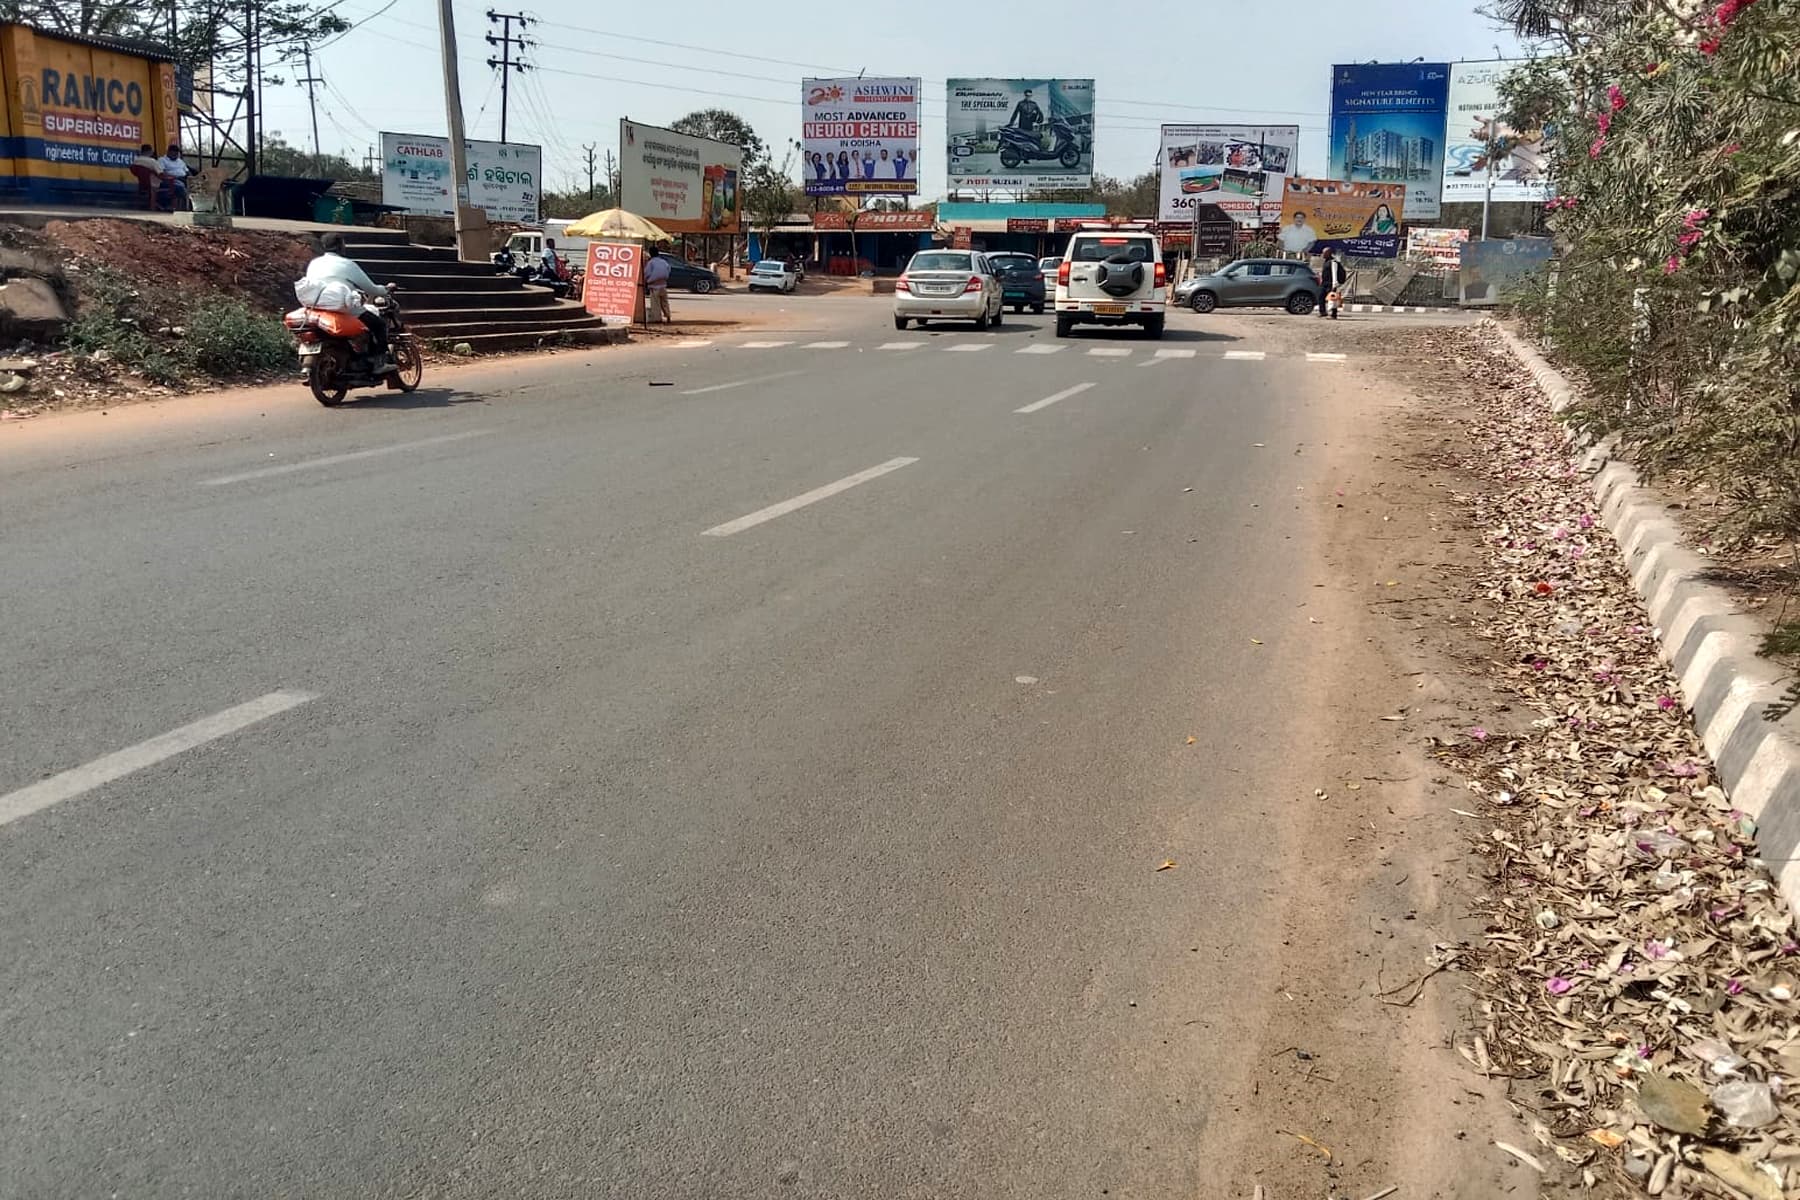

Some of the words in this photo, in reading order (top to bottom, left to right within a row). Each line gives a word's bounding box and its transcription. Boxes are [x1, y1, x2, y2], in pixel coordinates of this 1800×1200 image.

[42, 68, 142, 116] RAMCO
[855, 86, 913, 96] ASHWINI
[815, 112, 844, 121] MOST
[847, 112, 906, 121] ADVANCED
[45, 115, 140, 139] SUPERGRADE
[805, 123, 854, 137] NEURO
[861, 123, 916, 137] CENTRE
[44, 143, 84, 161] ngineered
[87, 146, 99, 161] for
[102, 149, 135, 164] Concret
[397, 146, 443, 158] CATHLAB
[873, 214, 924, 223] HOTEL
[595, 246, 633, 262] କାଠ
[592, 262, 632, 277] ଘଣା
